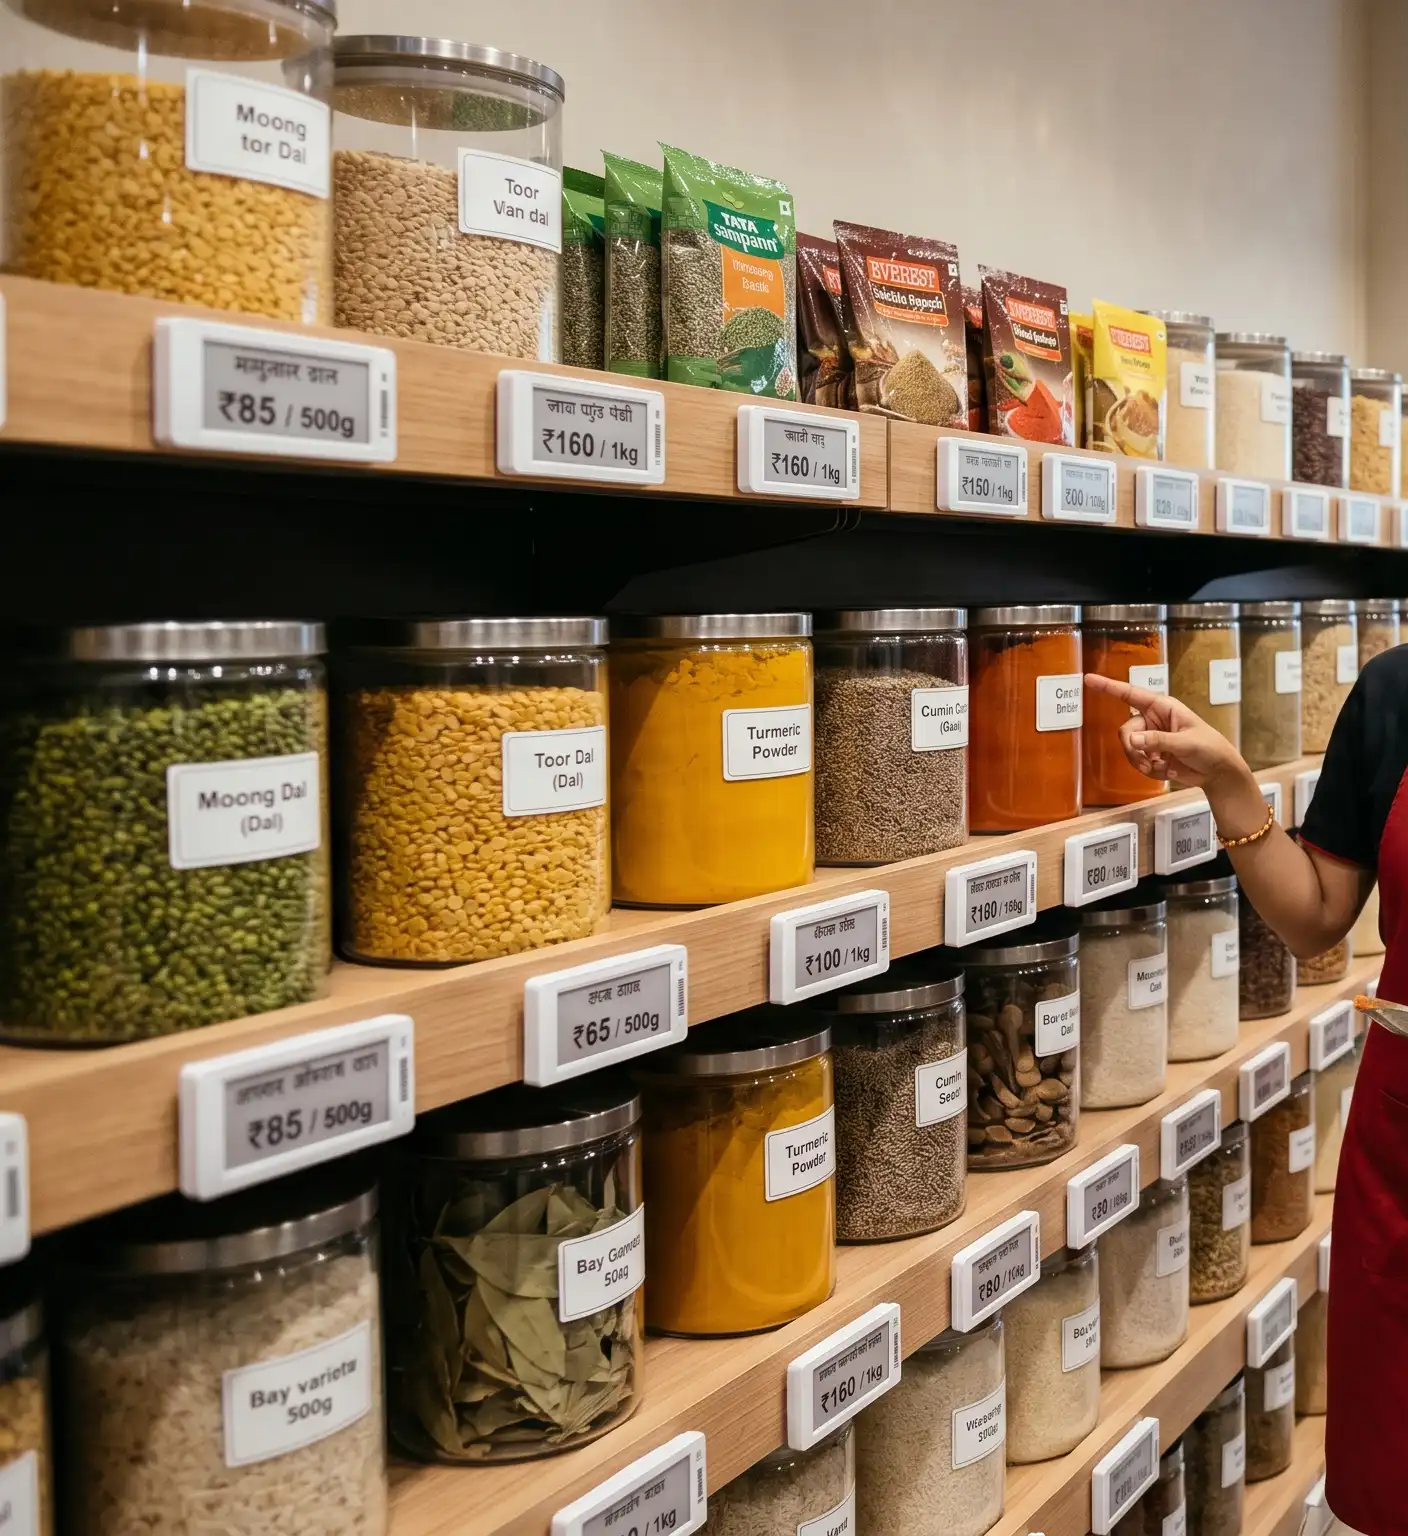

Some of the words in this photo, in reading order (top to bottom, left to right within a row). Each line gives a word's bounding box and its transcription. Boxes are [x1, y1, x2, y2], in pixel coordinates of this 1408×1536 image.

[236, 103, 306, 141] Moong
[241, 134, 271, 155] tor
[278, 140, 306, 165] Dal
[505, 178, 539, 200] Toor
[529, 208, 549, 227] dal
[721, 211, 759, 234] TATA
[713, 223, 779, 253] sampann
[869, 260, 936, 289] EVEREST
[218, 390, 276, 426] ₹85
[301, 406, 355, 438] 500g
[542, 428, 595, 458] ₹160
[611, 441, 639, 466] 1kg
[772, 452, 810, 478] ₹160
[821, 463, 840, 485] 1kg
[921, 703, 954, 718] Cumin
[746, 723, 801, 741] Turmeric
[534, 752, 571, 769] Toor
[575, 747, 594, 765] Dal
[752, 743, 798, 760] Powder
[552, 771, 584, 793] (Dal)
[198, 788, 275, 812] Moong
[280, 781, 308, 802] Dal
[240, 813, 284, 839] (Dal)
[805, 947, 841, 976] ₹100
[851, 946, 870, 963] 1kg
[572, 1017, 611, 1049] ₹65
[624, 1011, 660, 1035] 500g
[935, 1070, 962, 1089] Cumin
[249, 1110, 303, 1149] ₹85
[324, 1100, 372, 1129] 500g
[785, 1131, 829, 1159] Turmeric
[577, 1256, 605, 1275] Bay
[250, 1386, 291, 1410] Bay
[820, 1375, 856, 1414] ₹160
[866, 1363, 883, 1384] 1kg
[287, 1396, 333, 1425] 500g
[652, 1508, 677, 1533] 1kg
